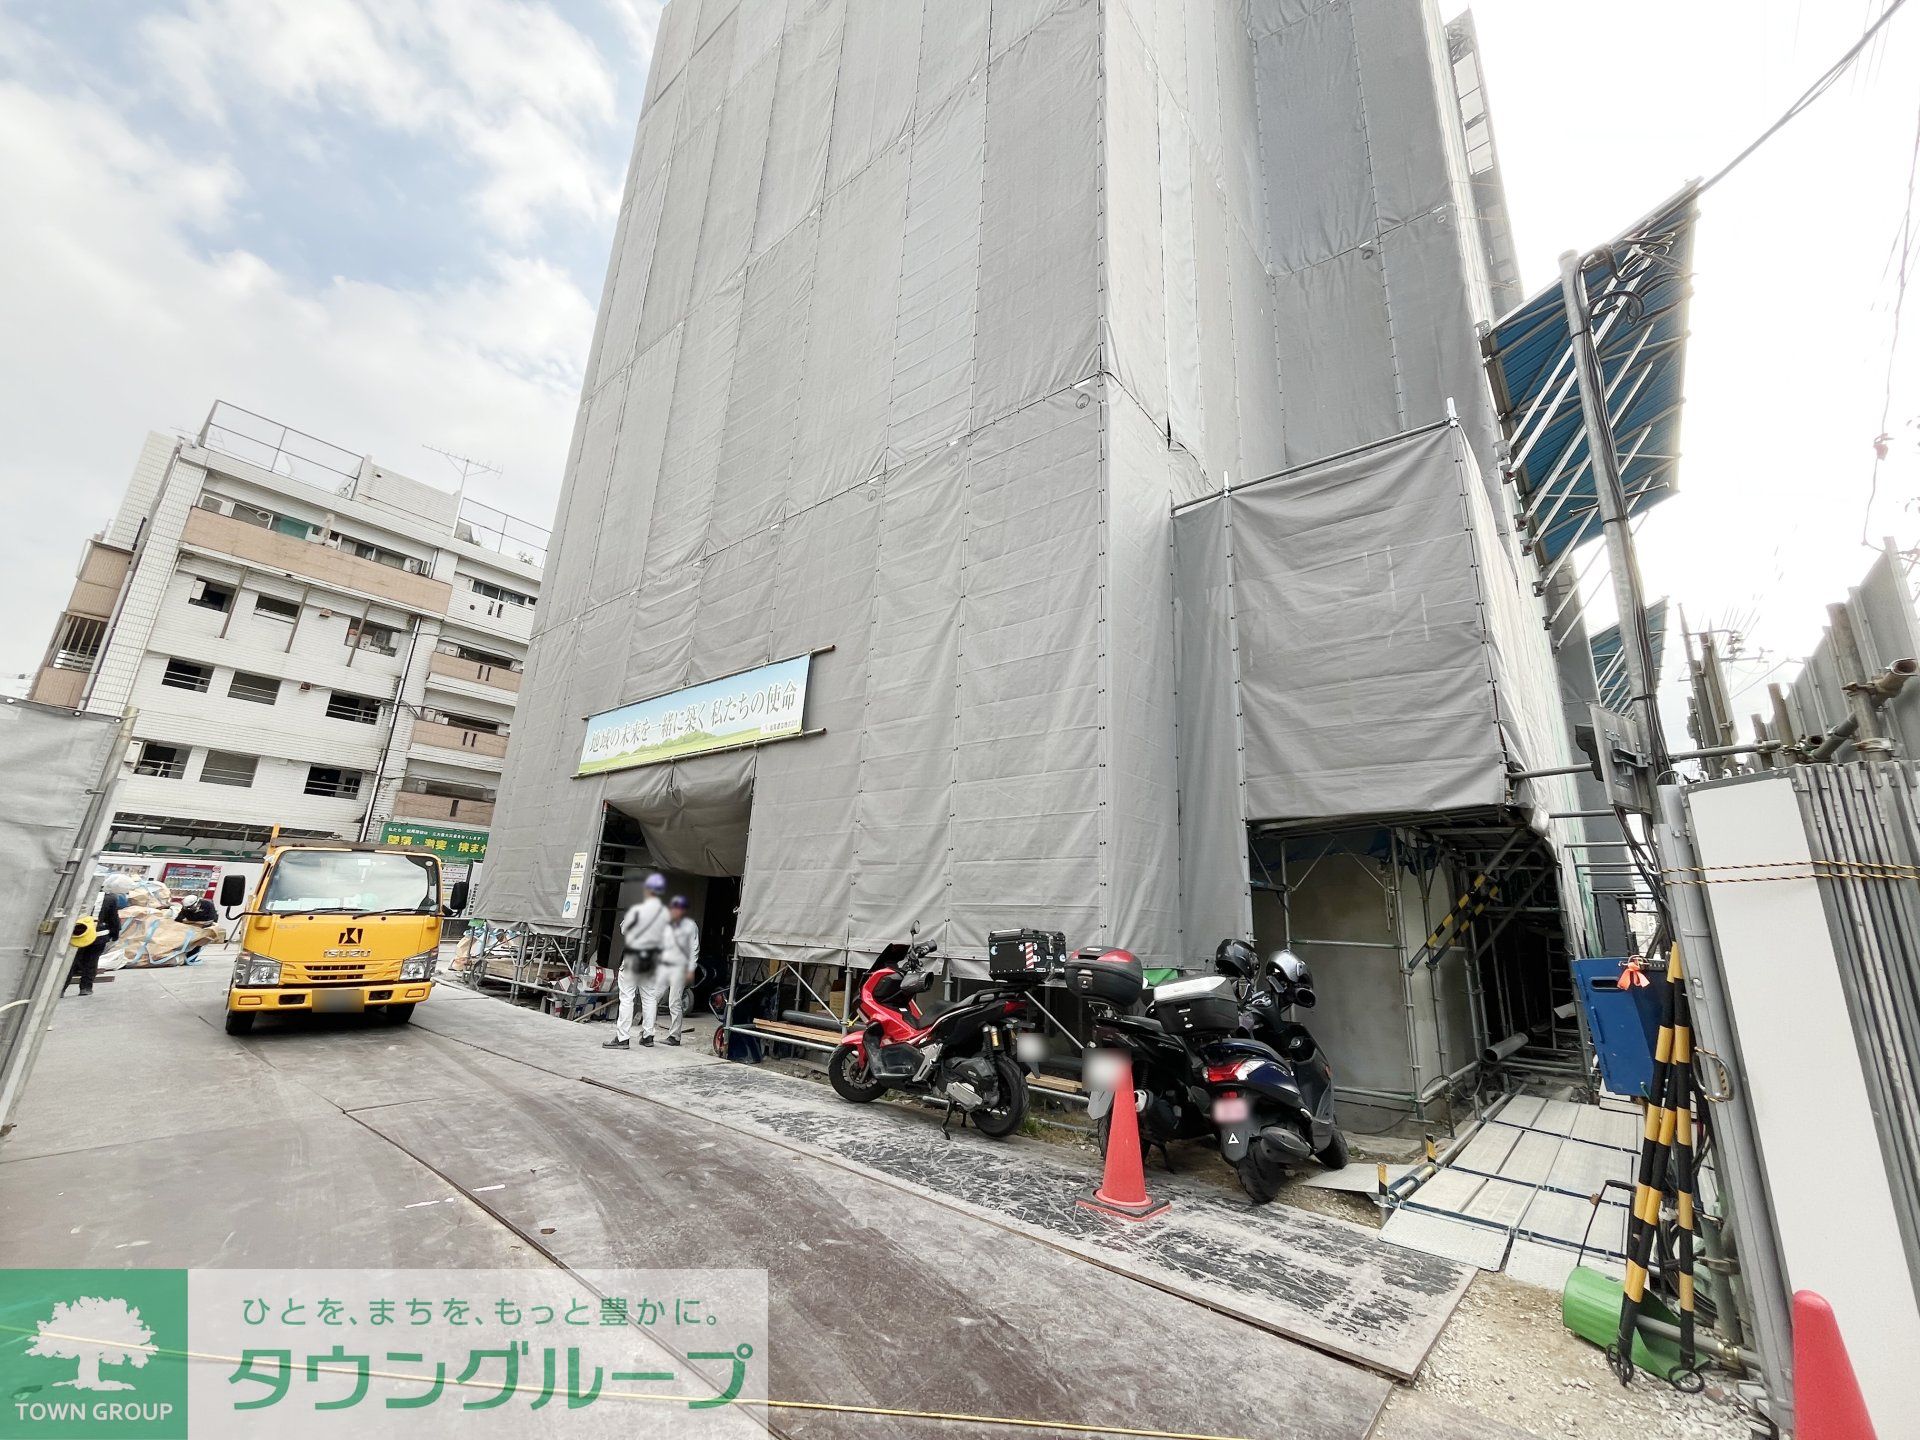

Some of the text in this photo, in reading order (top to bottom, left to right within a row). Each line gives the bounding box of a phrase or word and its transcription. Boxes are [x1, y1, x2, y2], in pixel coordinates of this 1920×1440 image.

[711, 681, 797, 727] 私たちの使命
[323, 949, 371, 958] ISUZU
